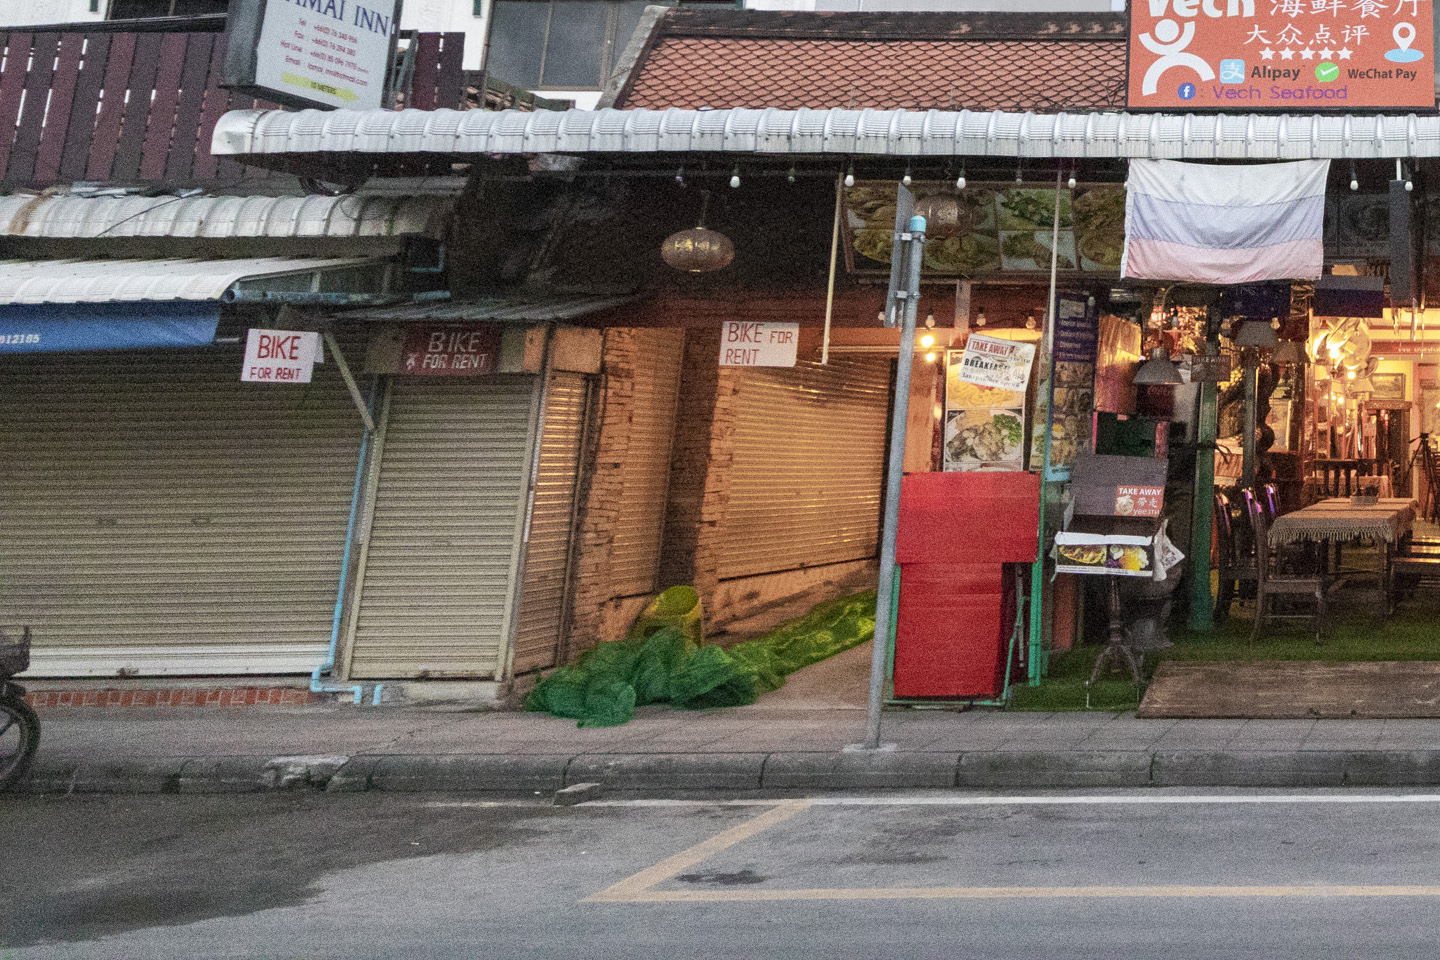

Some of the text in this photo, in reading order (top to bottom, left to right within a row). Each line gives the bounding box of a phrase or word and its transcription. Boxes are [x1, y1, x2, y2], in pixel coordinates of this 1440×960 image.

[354, 4, 389, 37] INN
[1243, 23, 1371, 46] 大众点评
[1250, 65, 1301, 82] Alipay
[1347, 68, 1418, 82] WeChat Pay
[1212, 85, 1348, 100] Vech Seafood
[727, 322, 793, 344] BIKE FOR
[257, 334, 302, 360] BIKE
[428, 331, 481, 353] BIKE
[971, 340, 1010, 355] TAKE AWAY
[422, 353, 488, 369] FOR RENT
[725, 348, 760, 365] RENT
[250, 366, 302, 381] FOR RENT
[1119, 487, 1162, 496] TAKE AWAY
[1133, 508, 1160, 516] увезти
